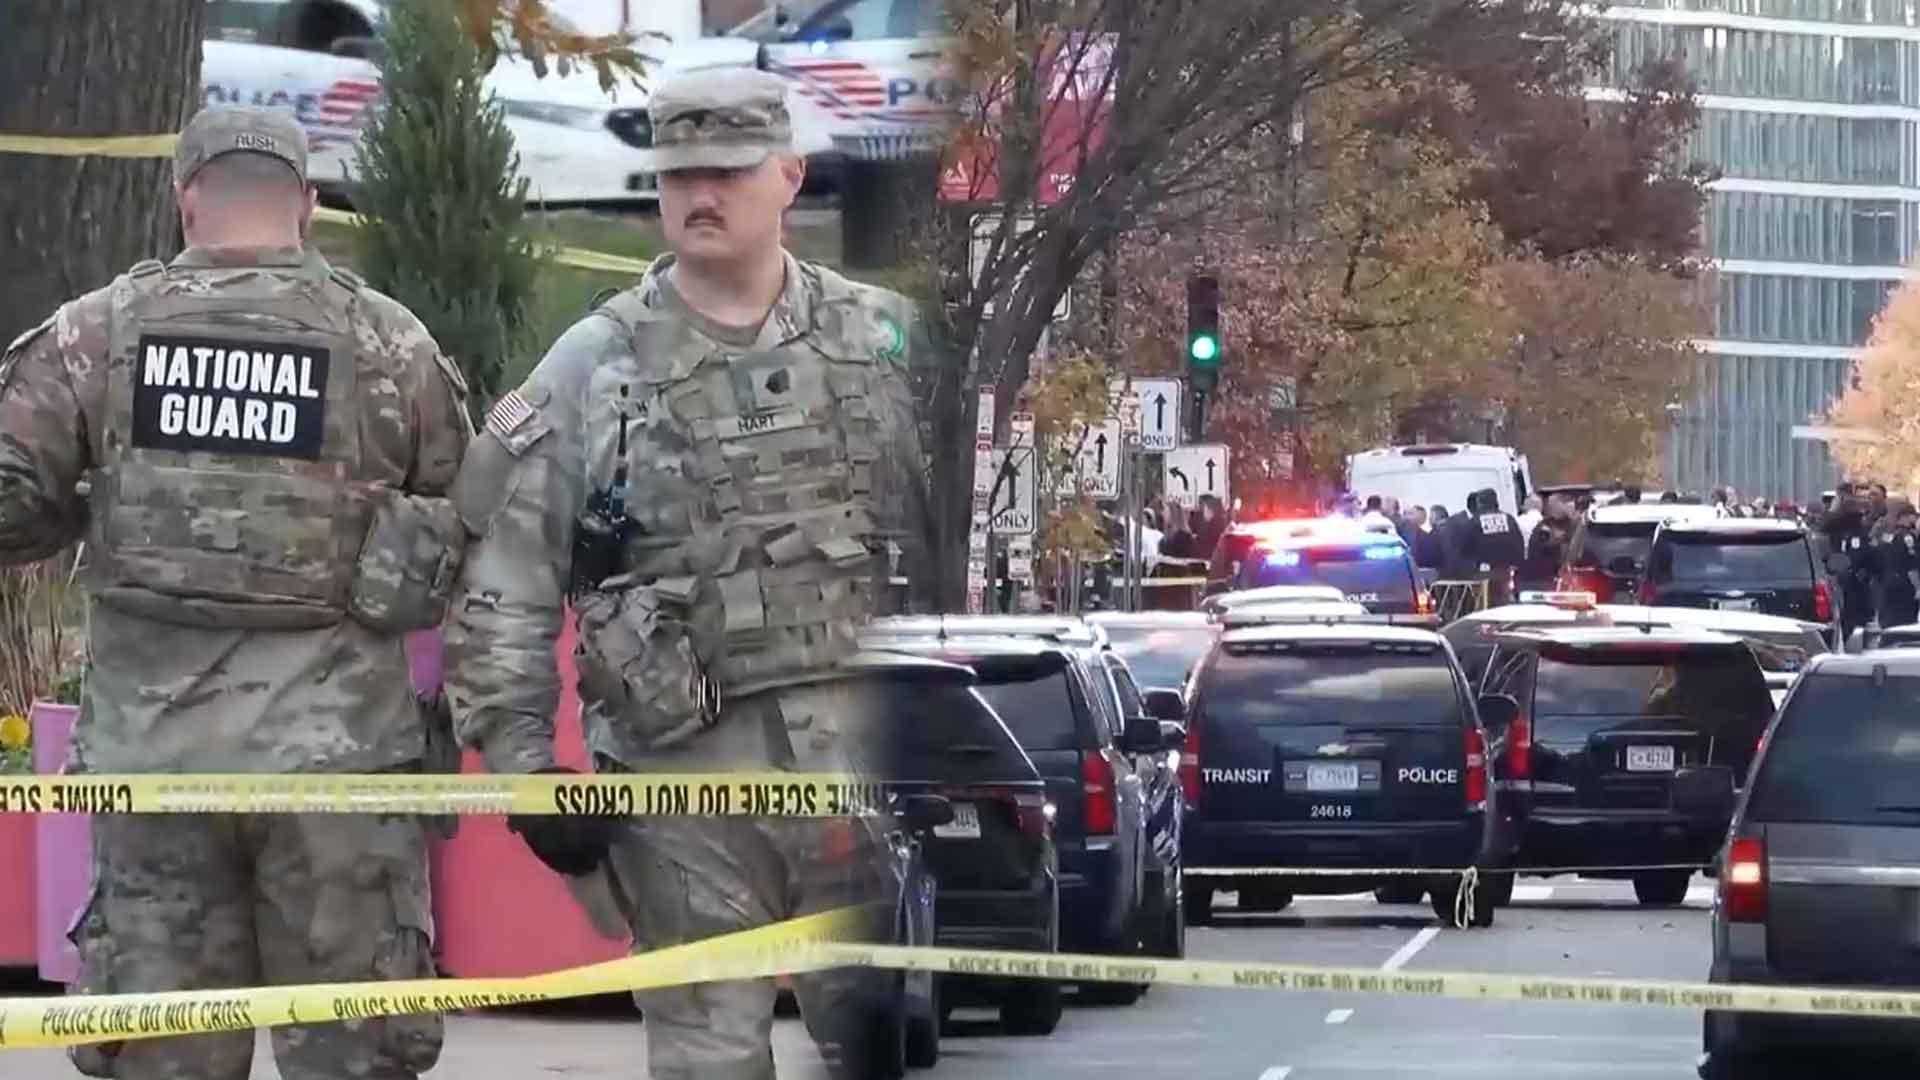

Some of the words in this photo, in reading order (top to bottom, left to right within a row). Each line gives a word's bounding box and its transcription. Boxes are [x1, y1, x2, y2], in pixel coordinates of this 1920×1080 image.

[235, 134, 276, 148] RUSH
[143, 344, 320, 399] NATIONAL
[159, 392, 297, 443] GUARD
[736, 414, 776, 433] HART
[1144, 435, 1173, 446] ONLY
[1082, 478, 1115, 494] ONLY
[994, 514, 1030, 528] ONLY
[1202, 768, 1272, 783] TRANSIT
[1398, 768, 1459, 784] POLICE
[52, 784, 133, 813] CRIME
[554, 784, 634, 815] CROSS
[645, 784, 689, 815] NOT
[699, 784, 731, 815] DO
[741, 784, 816, 815] SCENE
[1310, 804, 1352, 818] 24618
[41, 1005, 98, 1036] POLICE
[100, 1003, 135, 1033] LINE
[138, 1001, 160, 1033] DO
[164, 1000, 198, 1031] NOT
[200, 999, 253, 1029] CROSS
[333, 996, 391, 1019] POLICE
[392, 995, 427, 1016] LINE
